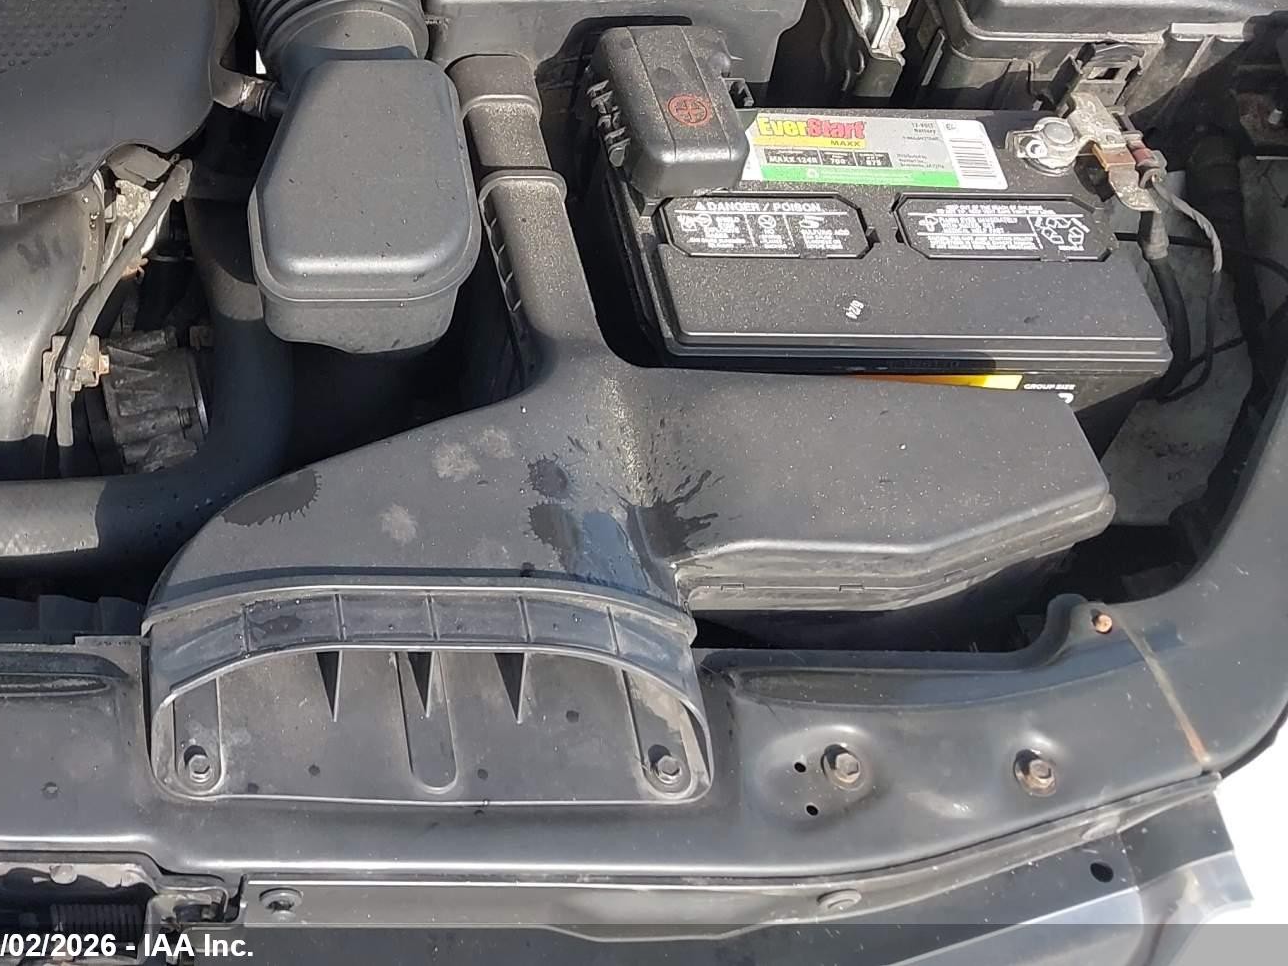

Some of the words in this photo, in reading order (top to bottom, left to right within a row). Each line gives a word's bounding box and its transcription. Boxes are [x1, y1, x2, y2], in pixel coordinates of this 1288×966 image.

[758, 117, 865, 139] EverStart
[830, 139, 861, 147] MAXX
[769, 155, 796, 163] MAXX
[707, 202, 762, 212] DANGER
[773, 202, 822, 212] POISON
